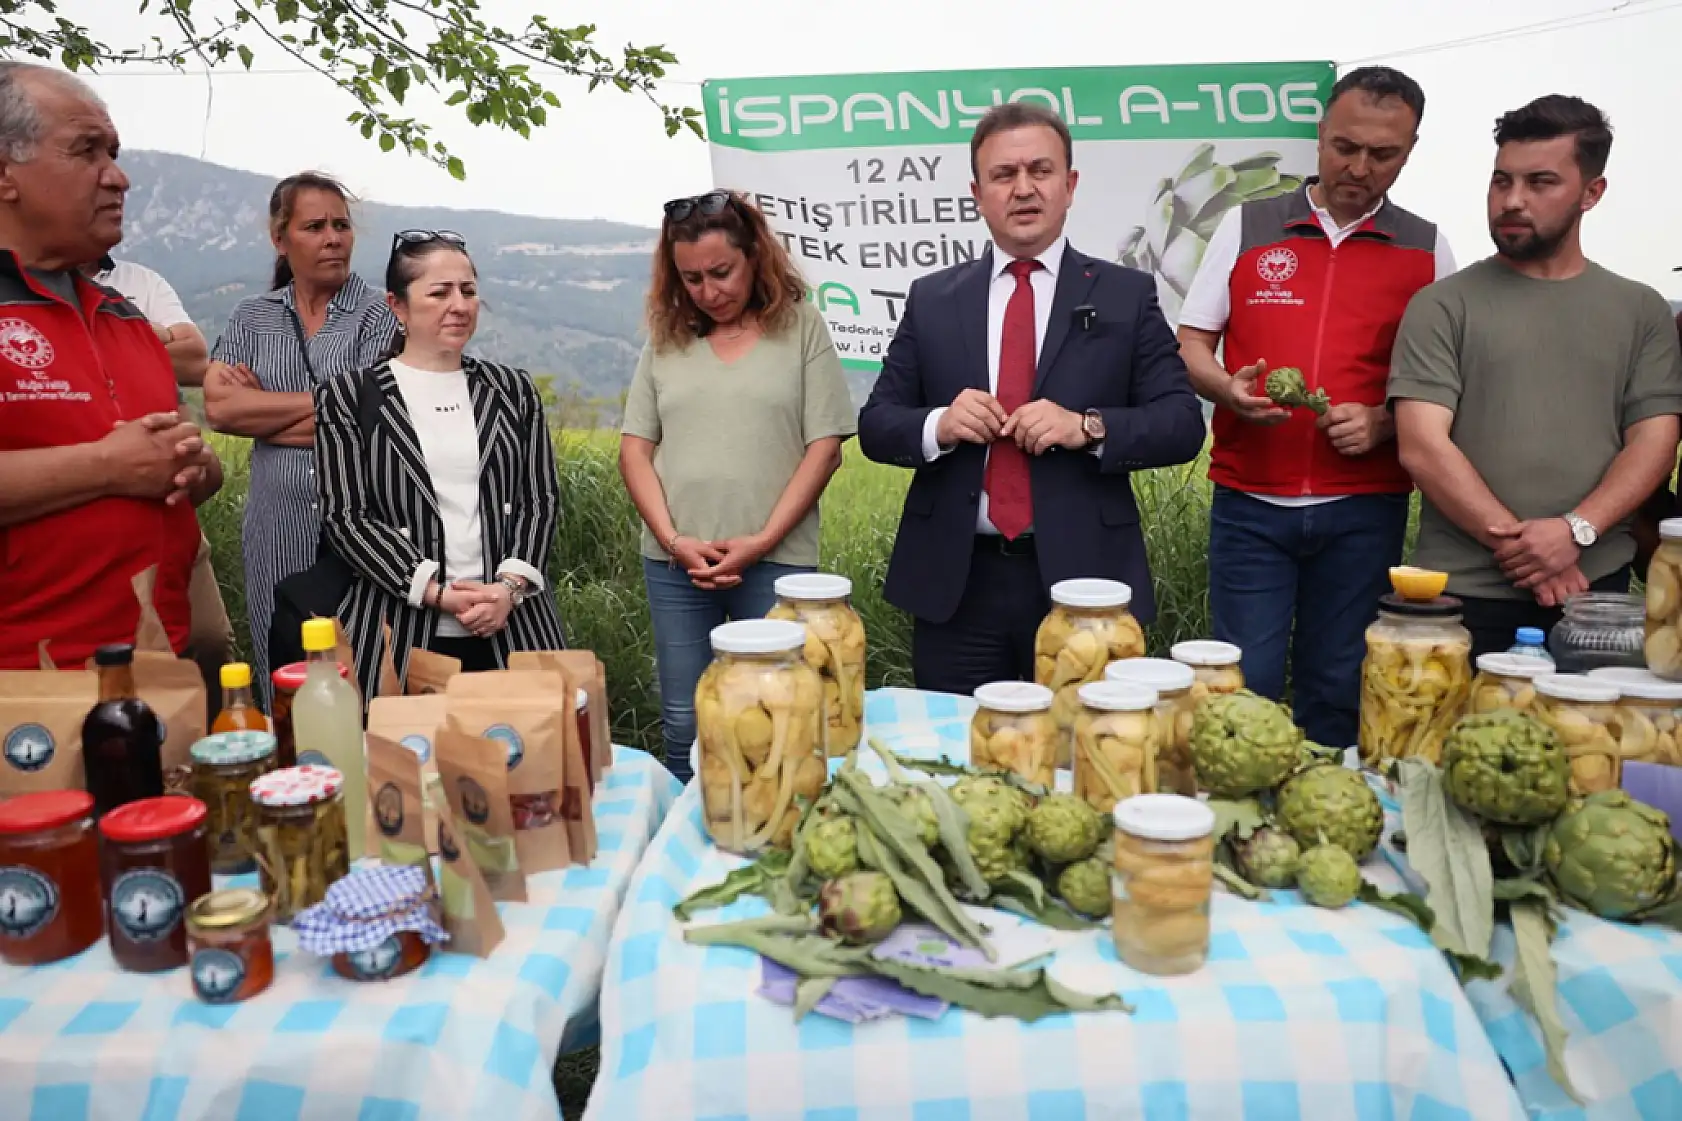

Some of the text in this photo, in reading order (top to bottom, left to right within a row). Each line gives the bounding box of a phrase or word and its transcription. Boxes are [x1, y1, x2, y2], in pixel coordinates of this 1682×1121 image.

[1119, 82, 1325, 125] A-106
[846, 156, 942, 183] 12 AY
[742, 192, 981, 232] ETİŞTİRİLEB
[776, 231, 848, 265] TEK
